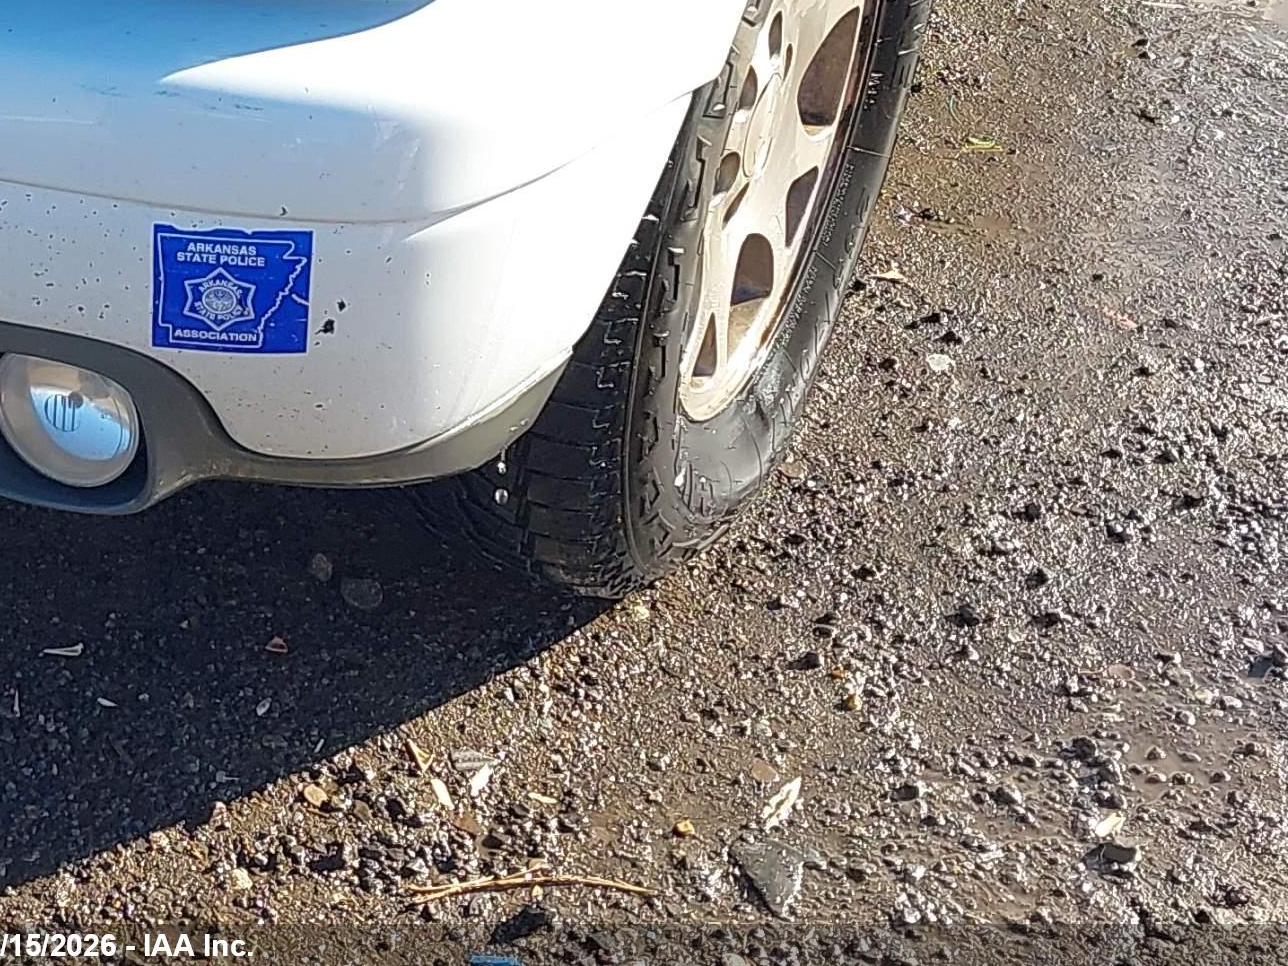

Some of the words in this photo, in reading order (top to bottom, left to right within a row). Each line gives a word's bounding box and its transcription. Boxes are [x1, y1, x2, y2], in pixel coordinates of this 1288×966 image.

[187, 242, 257, 256] ARKANSAS
[176, 251, 217, 264] STATE
[219, 254, 266, 267] POLICE
[198, 279, 243, 298] ARKANSAS
[193, 301, 216, 321] STATE
[175, 329, 257, 342] ASSOCIATION
